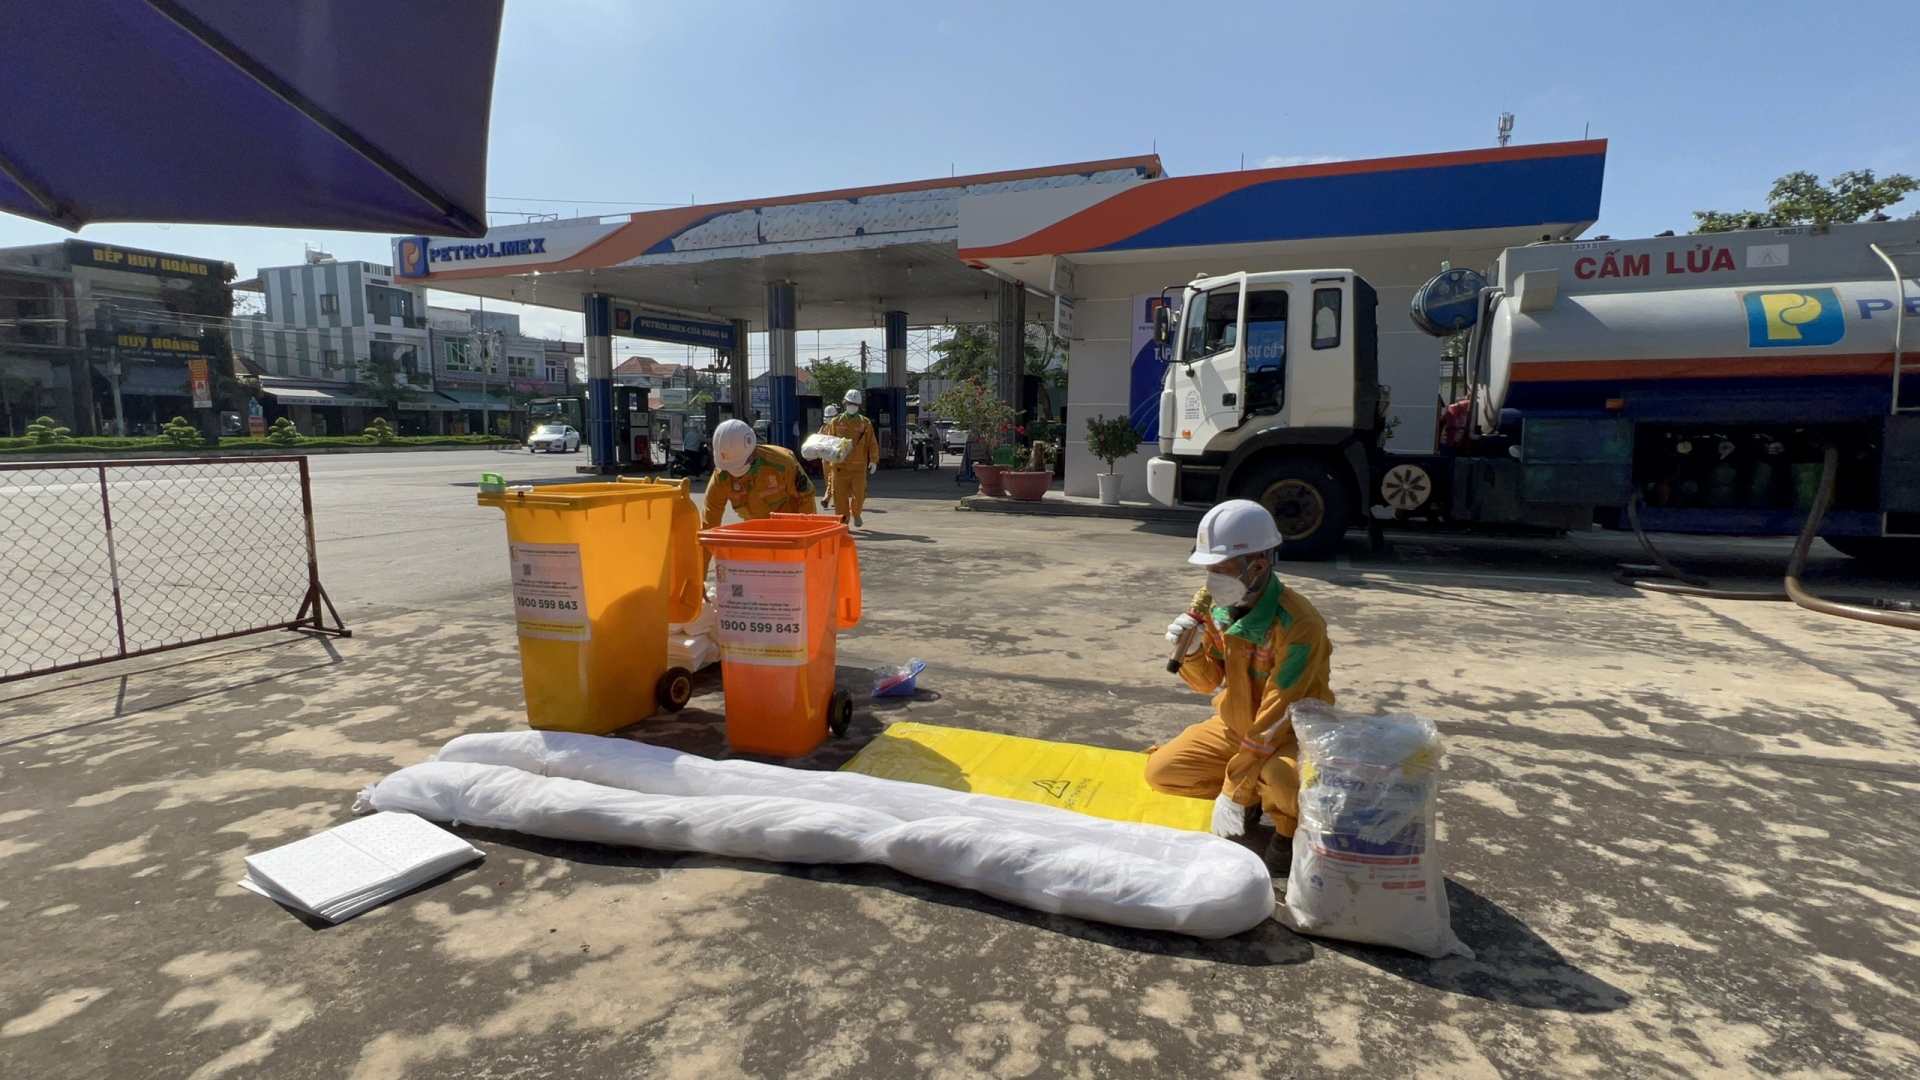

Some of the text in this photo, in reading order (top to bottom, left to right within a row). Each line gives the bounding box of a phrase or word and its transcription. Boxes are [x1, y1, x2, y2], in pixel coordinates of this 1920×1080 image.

[429, 238, 547, 263] PETROLIMEX
[127, 253, 157, 268] HUY
[161, 258, 208, 276] HOÀNG
[1574, 244, 1735, 280] CẤM LỬA
[118, 335, 200, 351] HUY HOÀNG
[1247, 345, 1262, 361] SỰ
[517, 597, 578, 611] 1900 599 843
[721, 619, 800, 634] 1900 599 843
